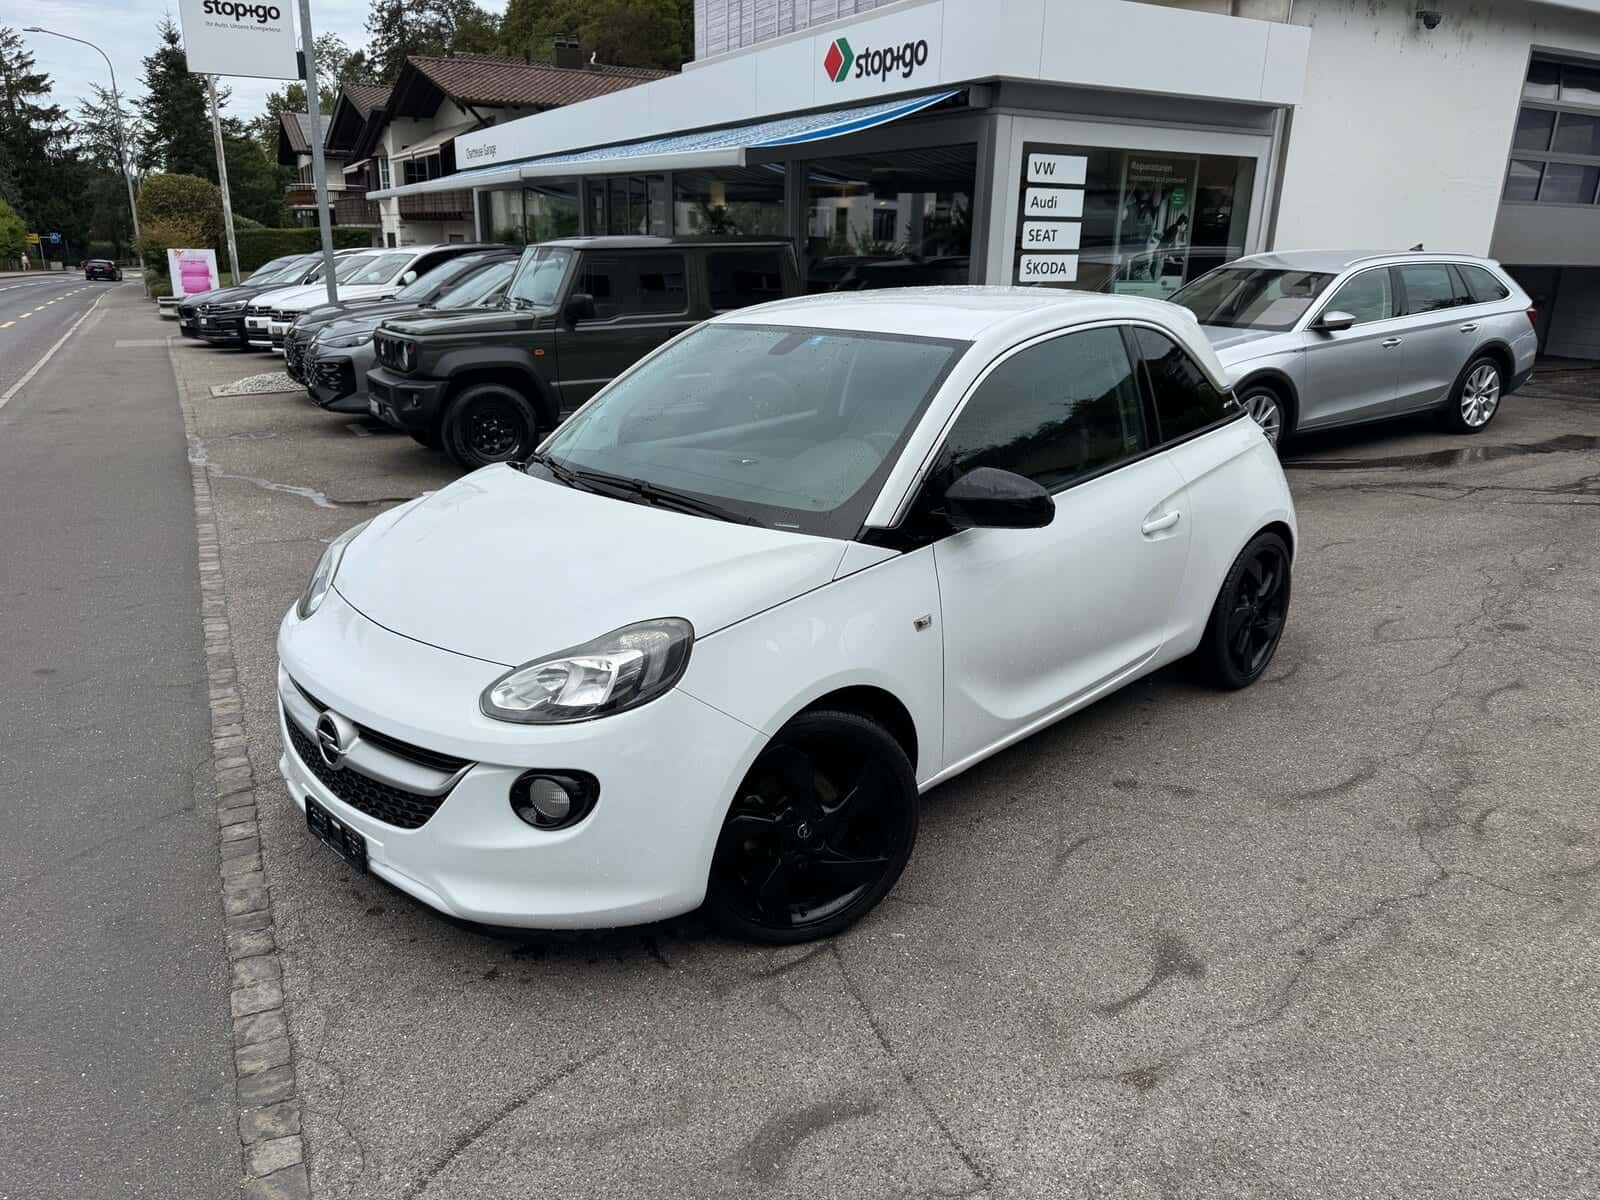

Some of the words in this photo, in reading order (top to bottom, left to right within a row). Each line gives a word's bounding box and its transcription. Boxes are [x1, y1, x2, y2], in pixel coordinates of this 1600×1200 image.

[203, 0, 281, 23] stop+go
[855, 39, 928, 82] stop+go
[1033, 161, 1056, 176] VW
[1030, 195, 1058, 209] Audi
[1028, 228, 1058, 242] SEAT
[1025, 259, 1067, 275] ŠKODA
